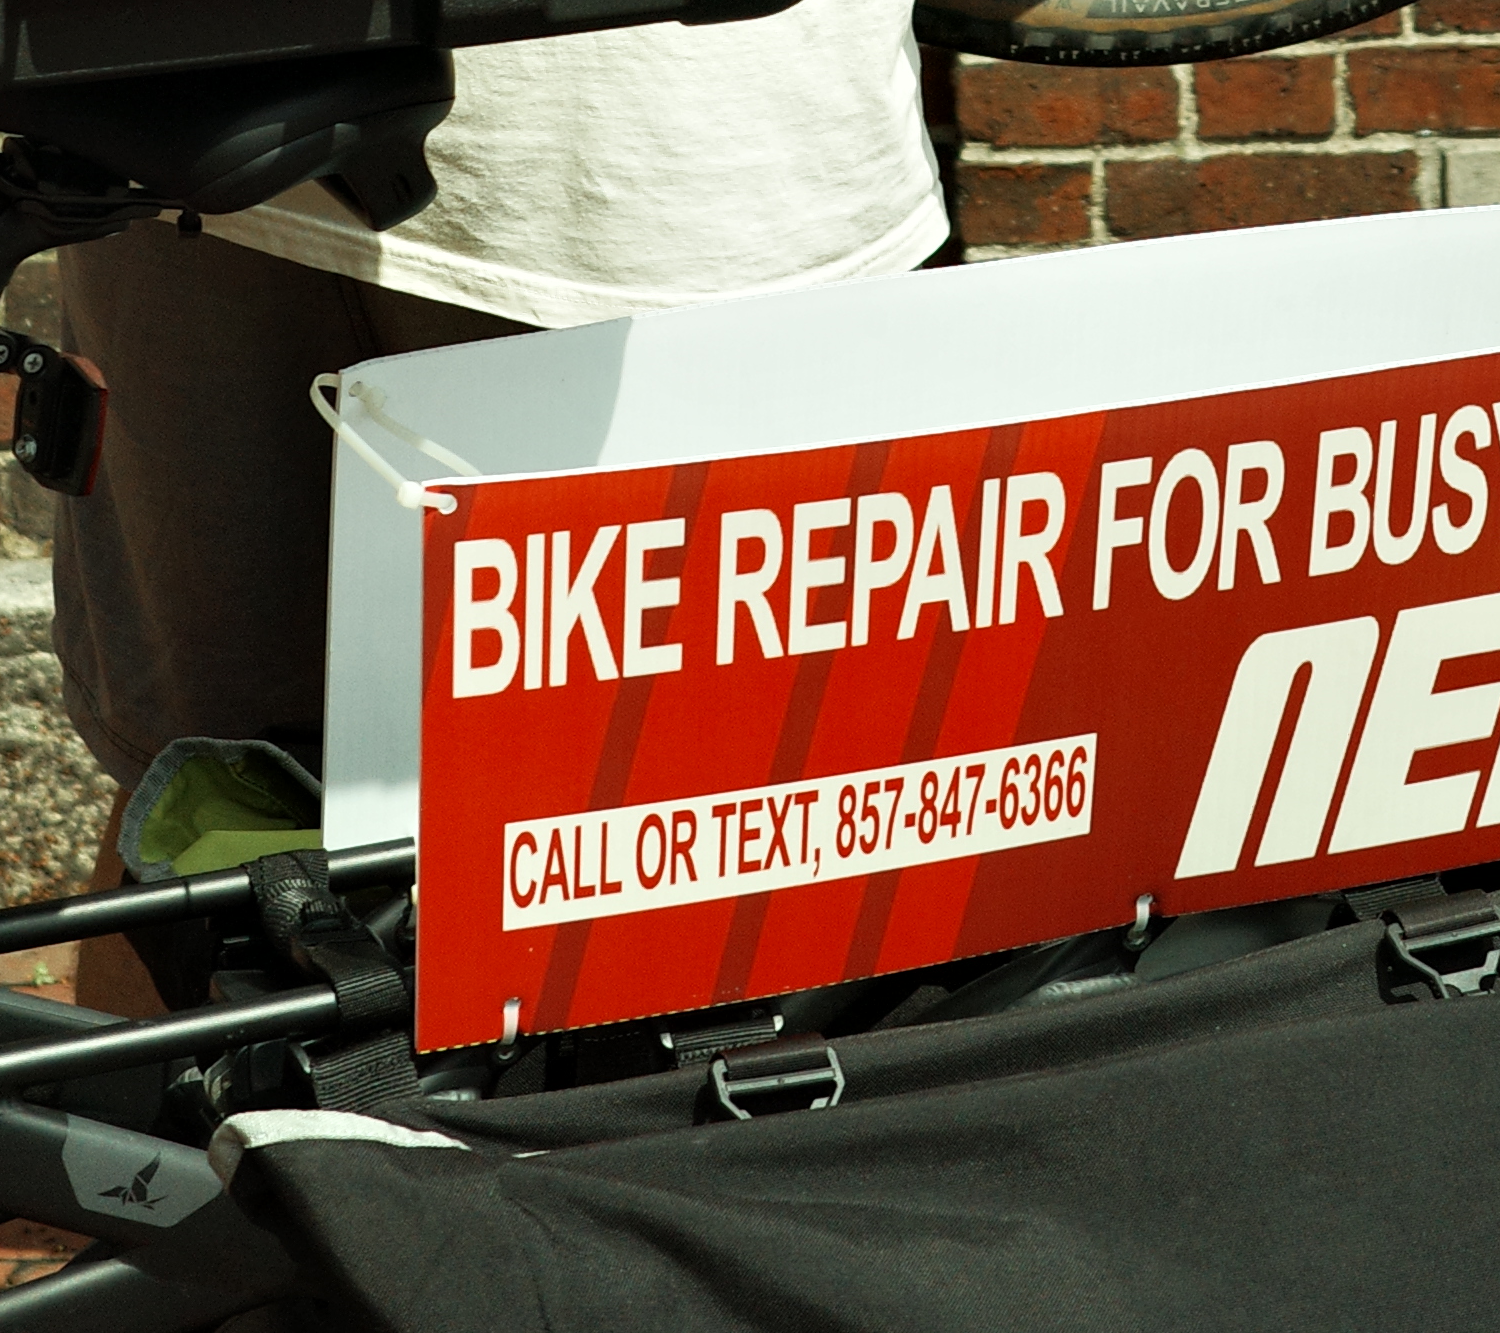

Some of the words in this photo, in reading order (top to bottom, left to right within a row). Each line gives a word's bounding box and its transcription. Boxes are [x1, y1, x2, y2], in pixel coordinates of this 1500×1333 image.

[452, 518, 685, 699] BIKE
[717, 472, 1067, 666] REPAIR
[1094, 441, 1284, 613] FOR
[509, 817, 622, 908] CALL
[634, 803, 700, 890] OR
[712, 785, 824, 879] TEXT,
[835, 745, 1088, 859] 857-847-6366
